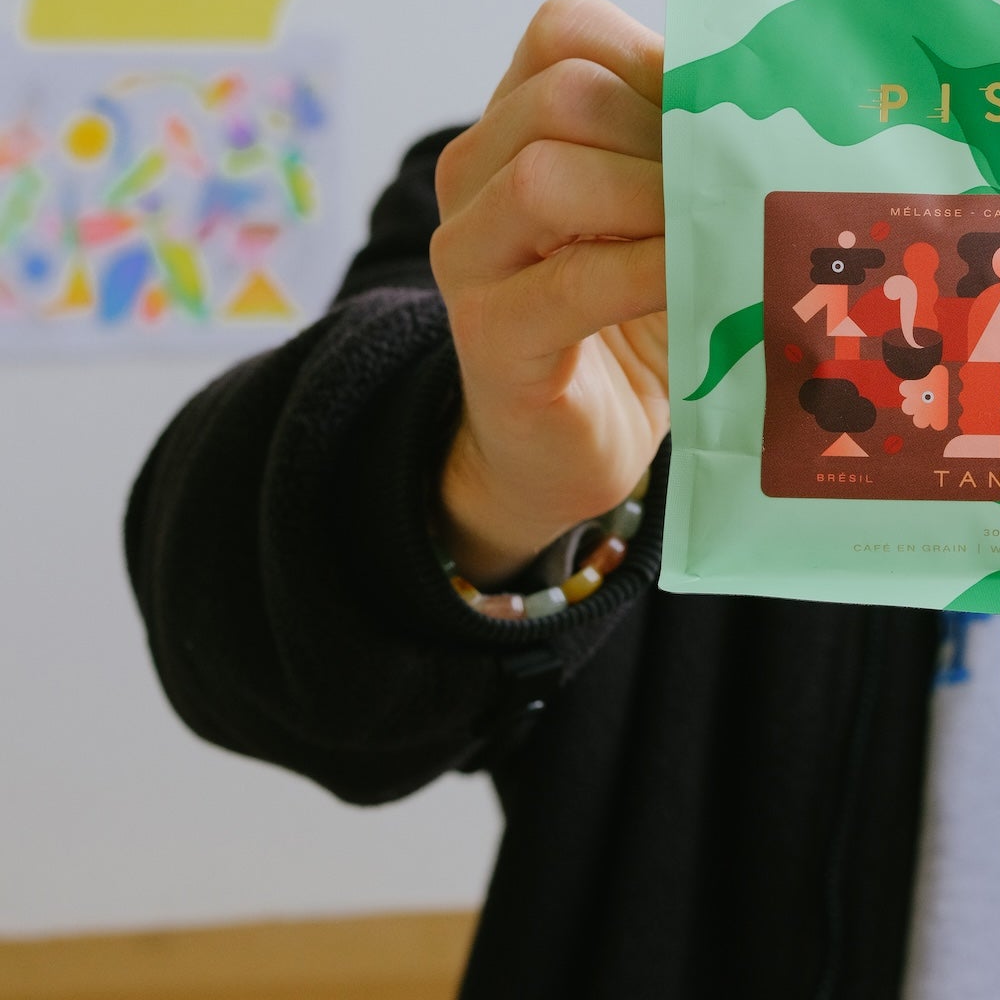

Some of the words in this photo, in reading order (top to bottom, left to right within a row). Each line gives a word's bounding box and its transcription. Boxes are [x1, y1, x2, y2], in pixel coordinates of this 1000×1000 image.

[890, 206, 963, 218] MÉLASSE
[816, 472, 873, 483] BRÉSIL
[853, 543, 891, 553] CAFÉ
[897, 544, 916, 553] EN
[921, 544, 967, 553] GRAIN
